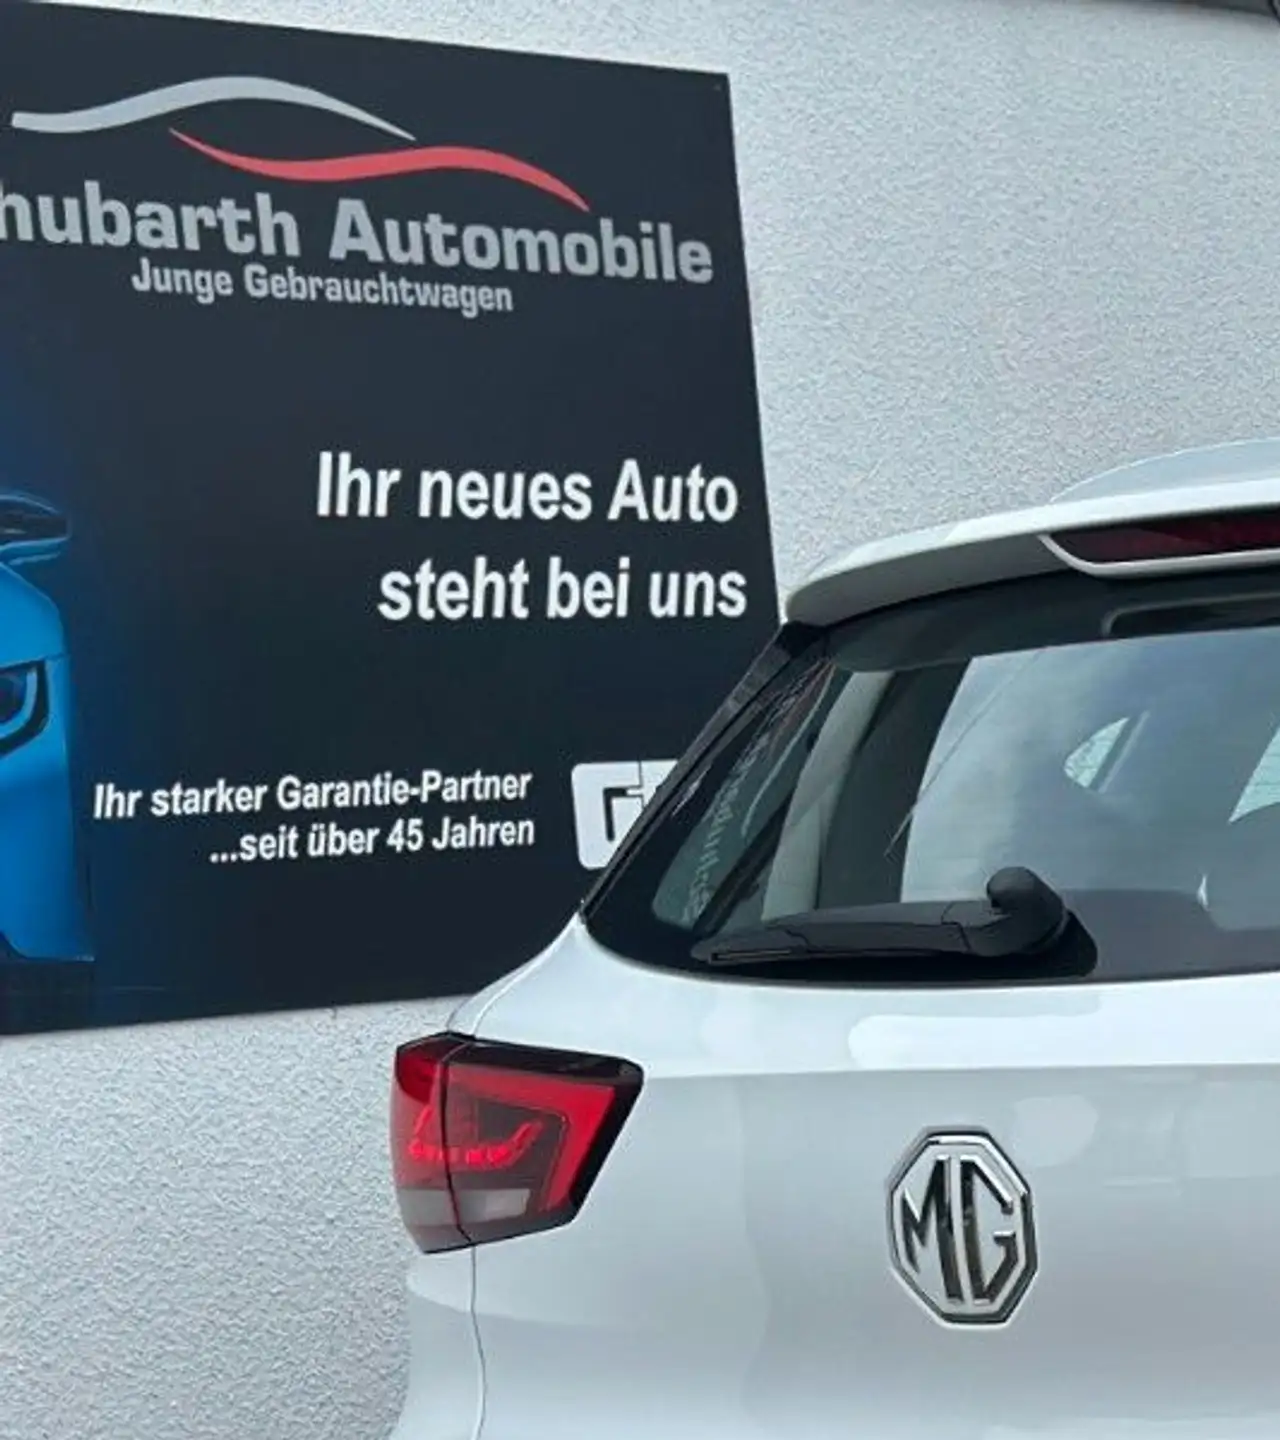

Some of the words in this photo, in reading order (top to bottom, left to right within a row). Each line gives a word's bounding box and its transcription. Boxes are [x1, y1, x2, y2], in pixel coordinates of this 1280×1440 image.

[328, 198, 713, 284] Automobile
[131, 257, 234, 304] Junge
[244, 263, 513, 318] Gebrauchtwagen
[318, 451, 401, 517] Ihr
[419, 469, 592, 520] neues
[608, 459, 737, 522] Auto
[378, 556, 529, 620] steht
[547, 556, 630, 618] bei
[650, 571, 746, 617] uns
[94, 782, 142, 819] Ihr
[151, 778, 268, 816] starker
[277, 769, 532, 811] Garantie-Partner
[210, 823, 299, 863] ...seit
[308, 821, 380, 857] über
[387, 818, 423, 852] 45
[432, 816, 534, 850] Jahren
[900, 1152, 1020, 1305] MG
